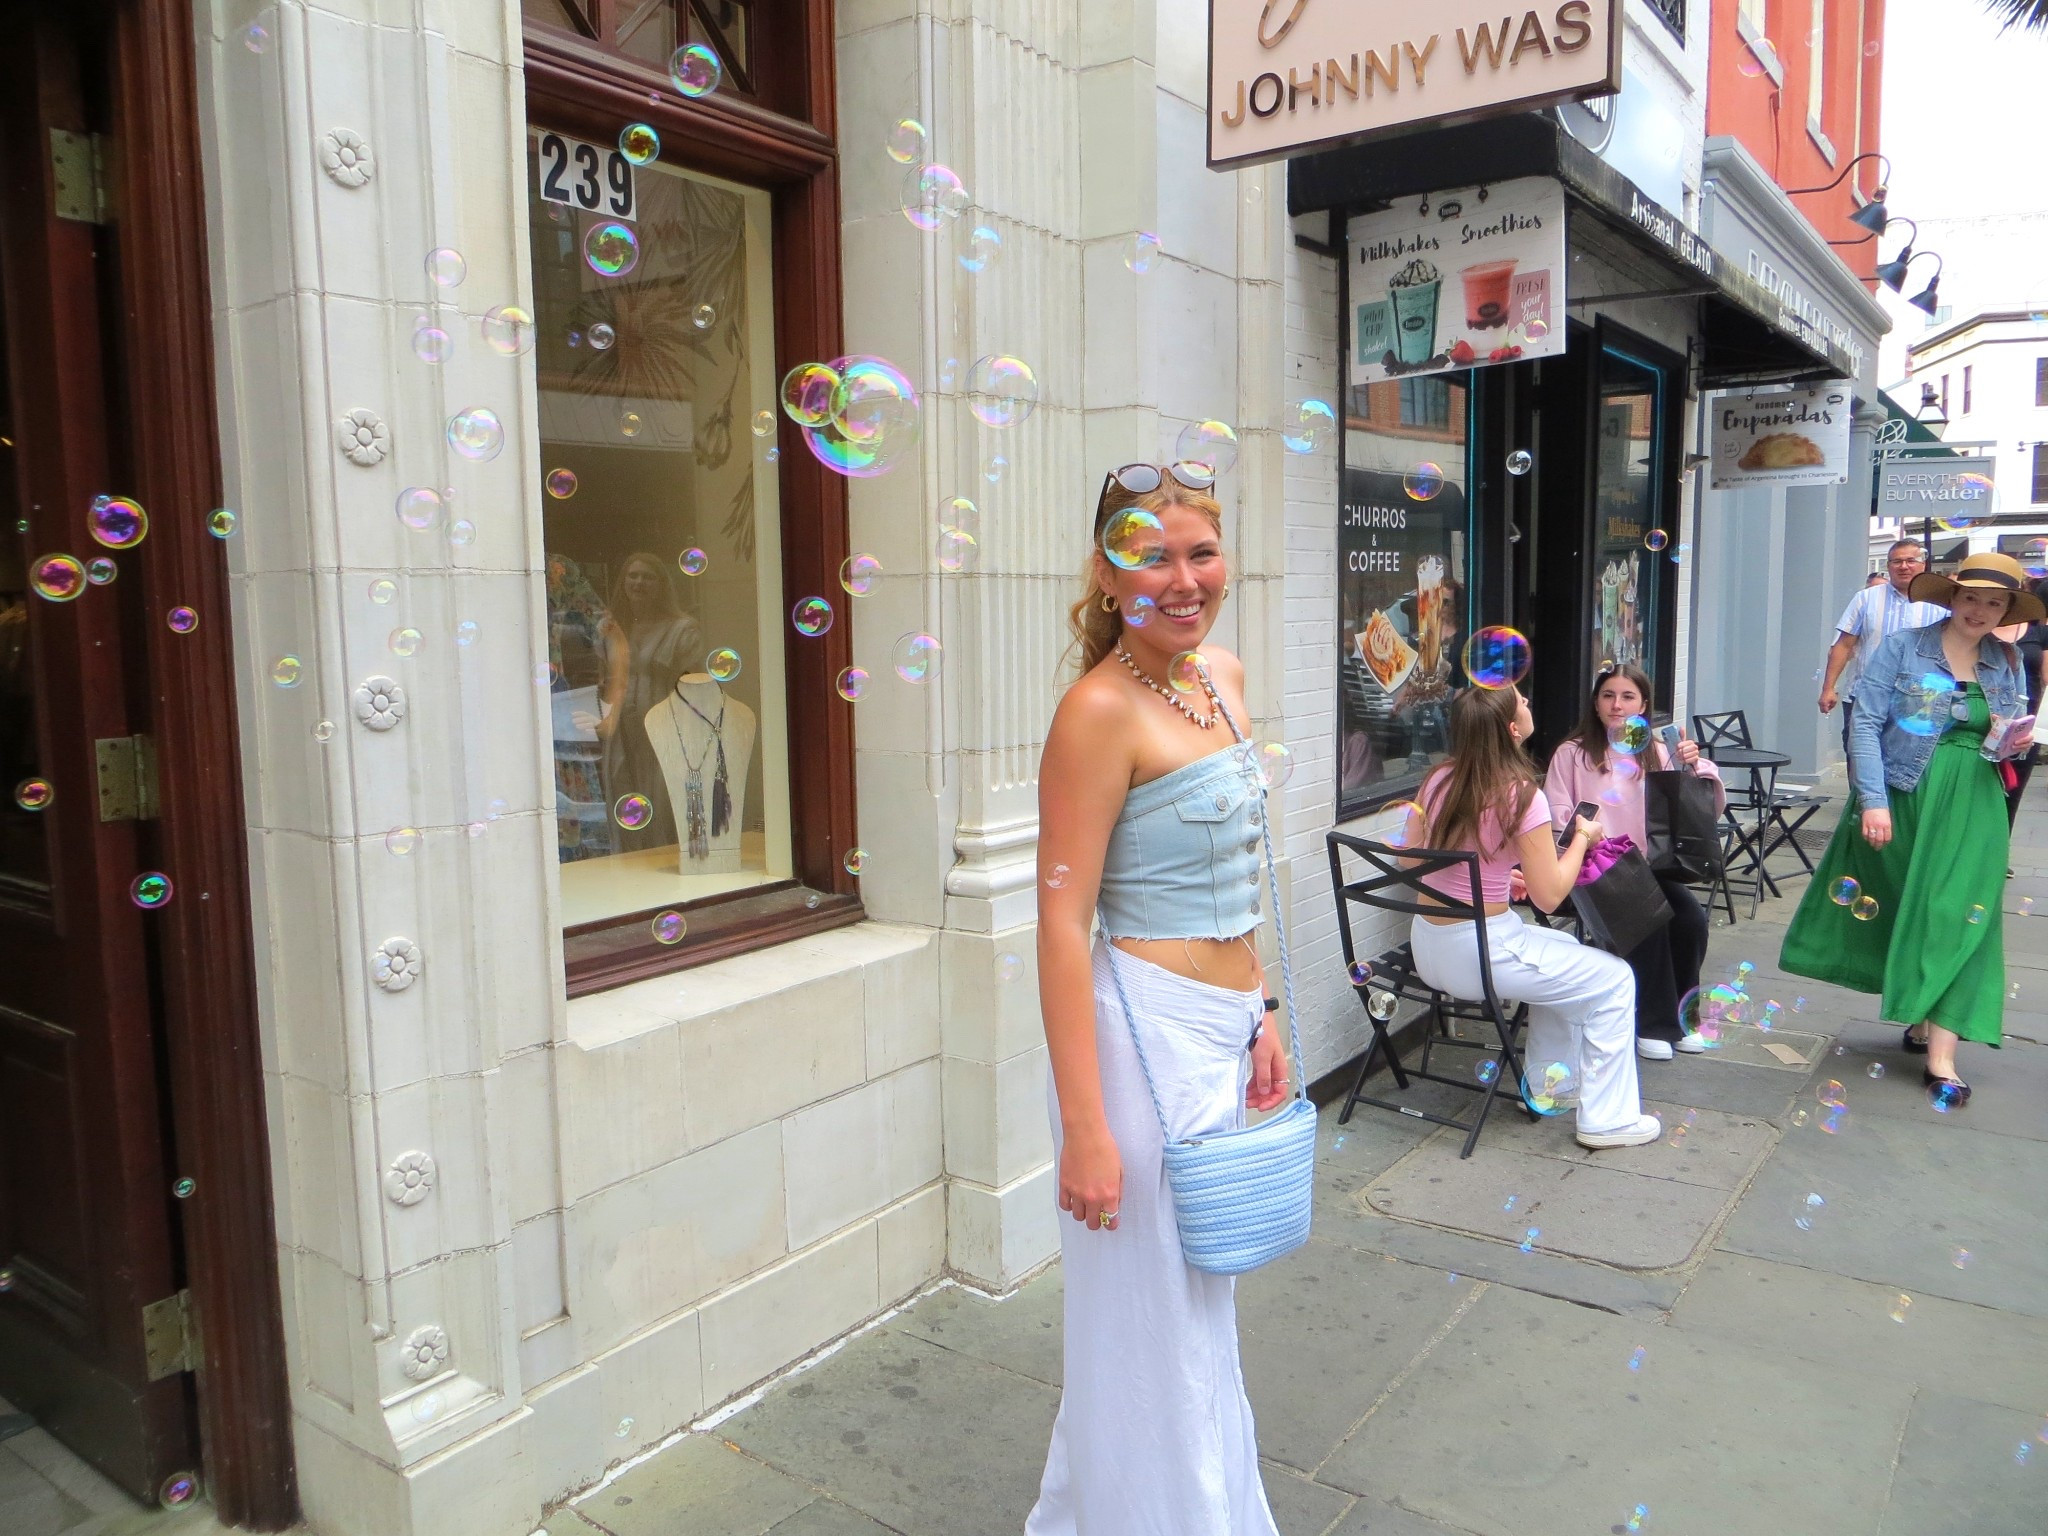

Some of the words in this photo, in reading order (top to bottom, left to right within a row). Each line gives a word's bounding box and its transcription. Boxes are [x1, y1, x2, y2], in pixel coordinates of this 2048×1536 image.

[1221, 34, 1441, 127] JOHNNY
[1455, 0, 1594, 74] WAS
[541, 134, 634, 216] 239
[1461, 213, 1542, 245] Smoothies
[1361, 234, 1440, 264] Milkshakes
[1680, 231, 1711, 275] GELATO
[1521, 293, 1542, 316] your
[1523, 302, 1544, 323] day!
[1723, 404, 1832, 435] Empanadas
[1886, 473, 1986, 486] EVERYTHING
[1886, 490, 1915, 501] BUT
[1918, 484, 1985, 501] water
[1371, 533, 1377, 547] &
[1349, 551, 1400, 572] COFFEE
